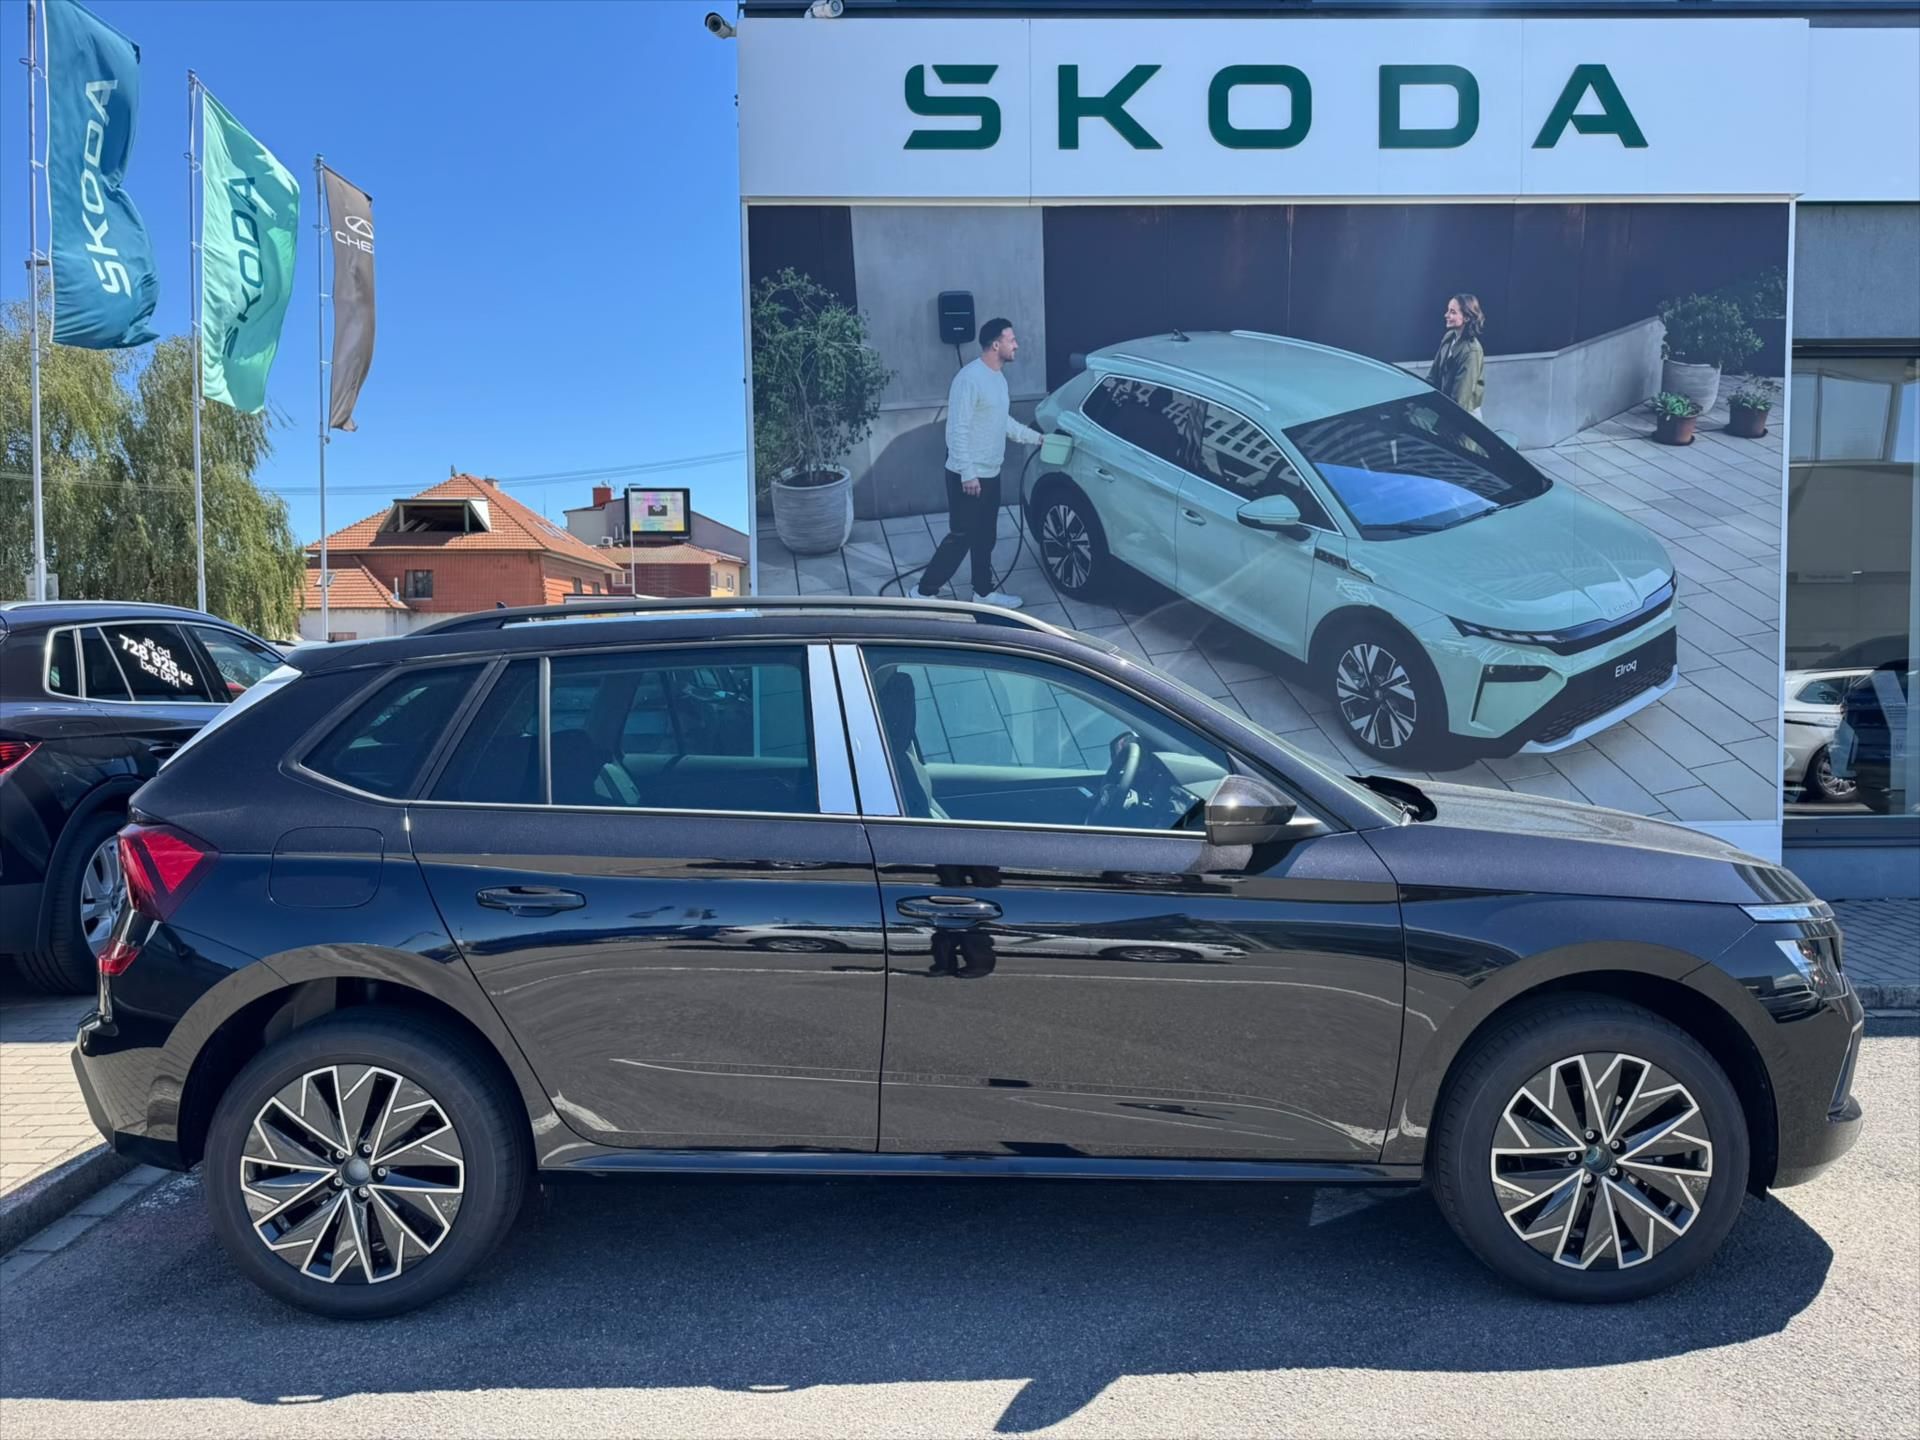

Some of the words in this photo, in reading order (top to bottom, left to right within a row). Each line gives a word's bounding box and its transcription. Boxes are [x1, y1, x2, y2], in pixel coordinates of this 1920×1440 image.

[335, 230, 375, 254] CHE
[119, 633, 149, 660] 728
[151, 651, 180, 677] 925
[160, 669, 180, 688] DPH
[1615, 659, 1637, 678] Elroq
